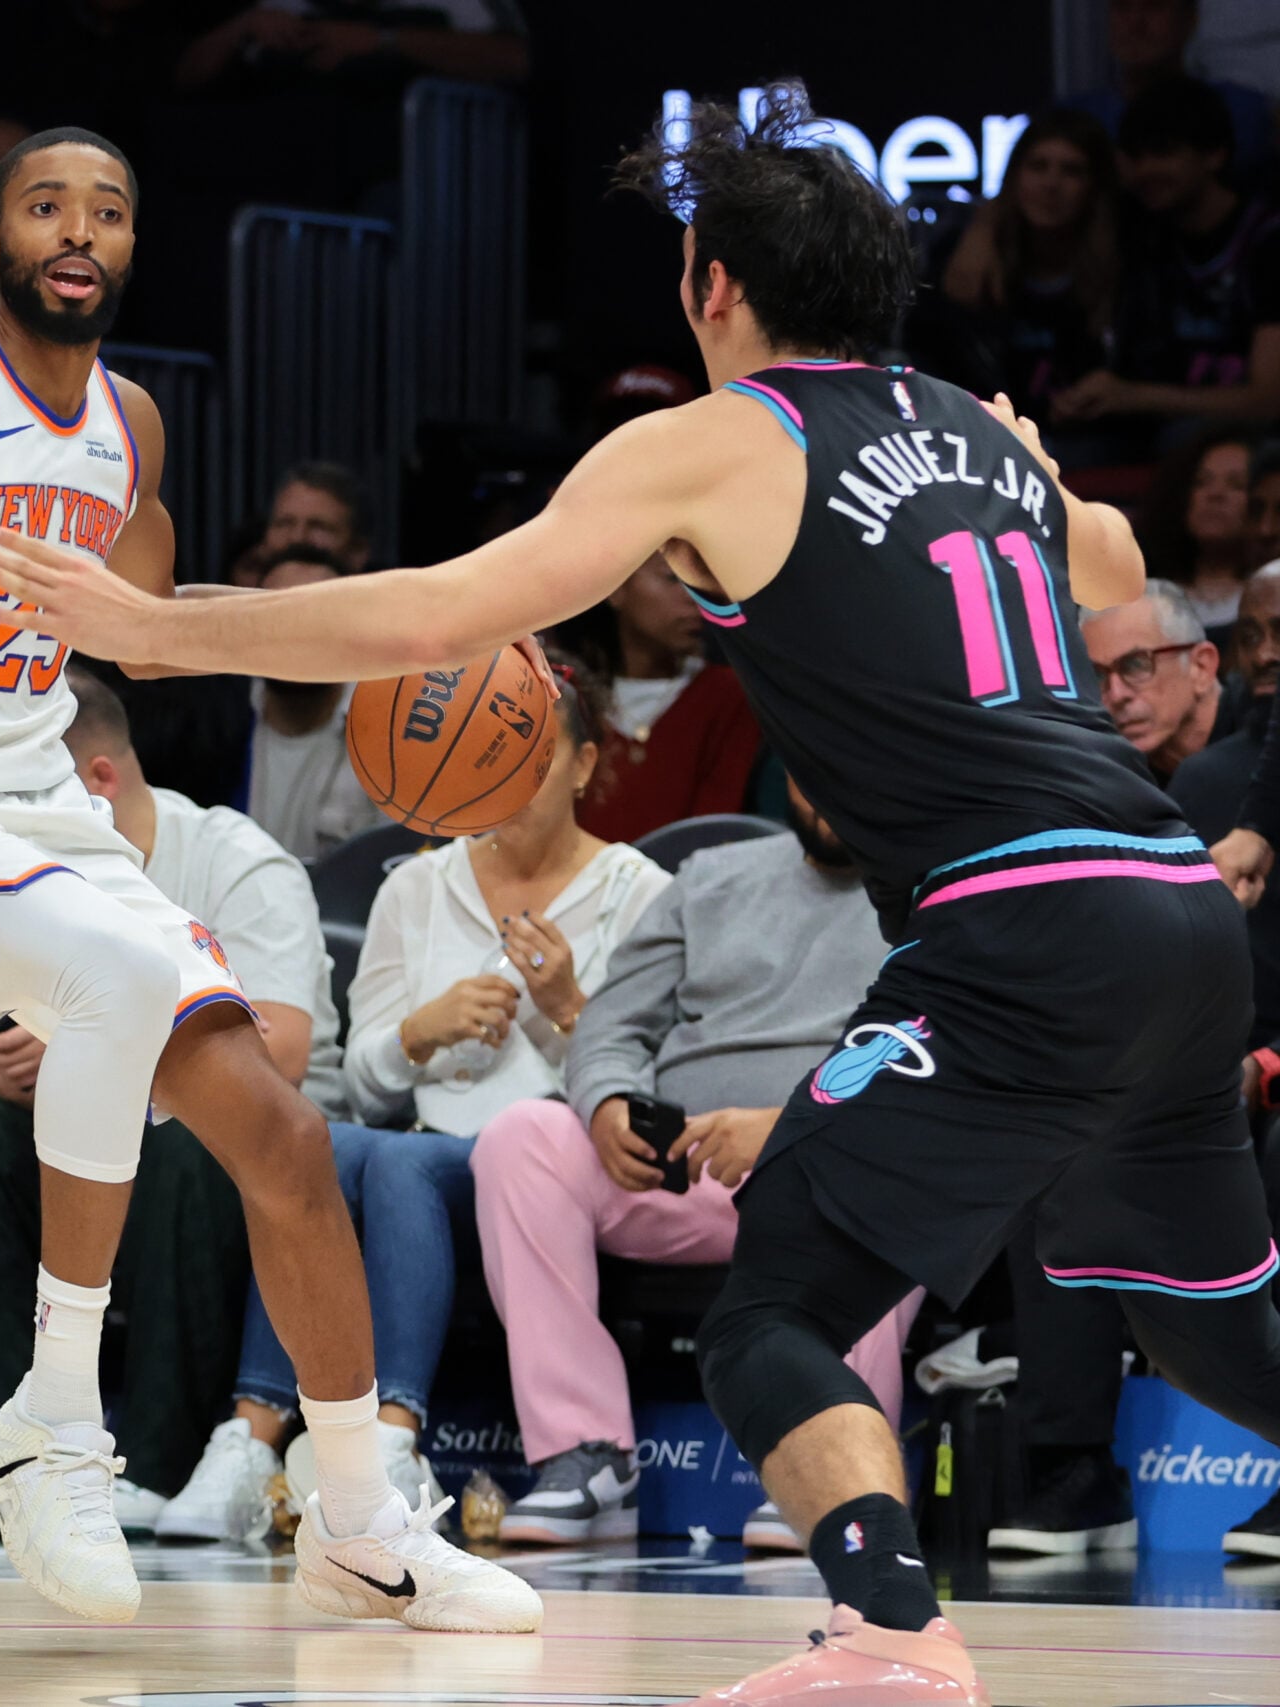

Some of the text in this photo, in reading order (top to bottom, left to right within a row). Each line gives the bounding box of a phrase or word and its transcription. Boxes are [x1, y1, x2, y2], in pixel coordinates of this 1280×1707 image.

[60, 488, 125, 560] YORK
[827, 430, 1051, 545] JAQUEZ JR.
[928, 530, 1079, 708] 11
[402, 667, 466, 743] Wil
[636, 1438, 705, 1470] ONE
